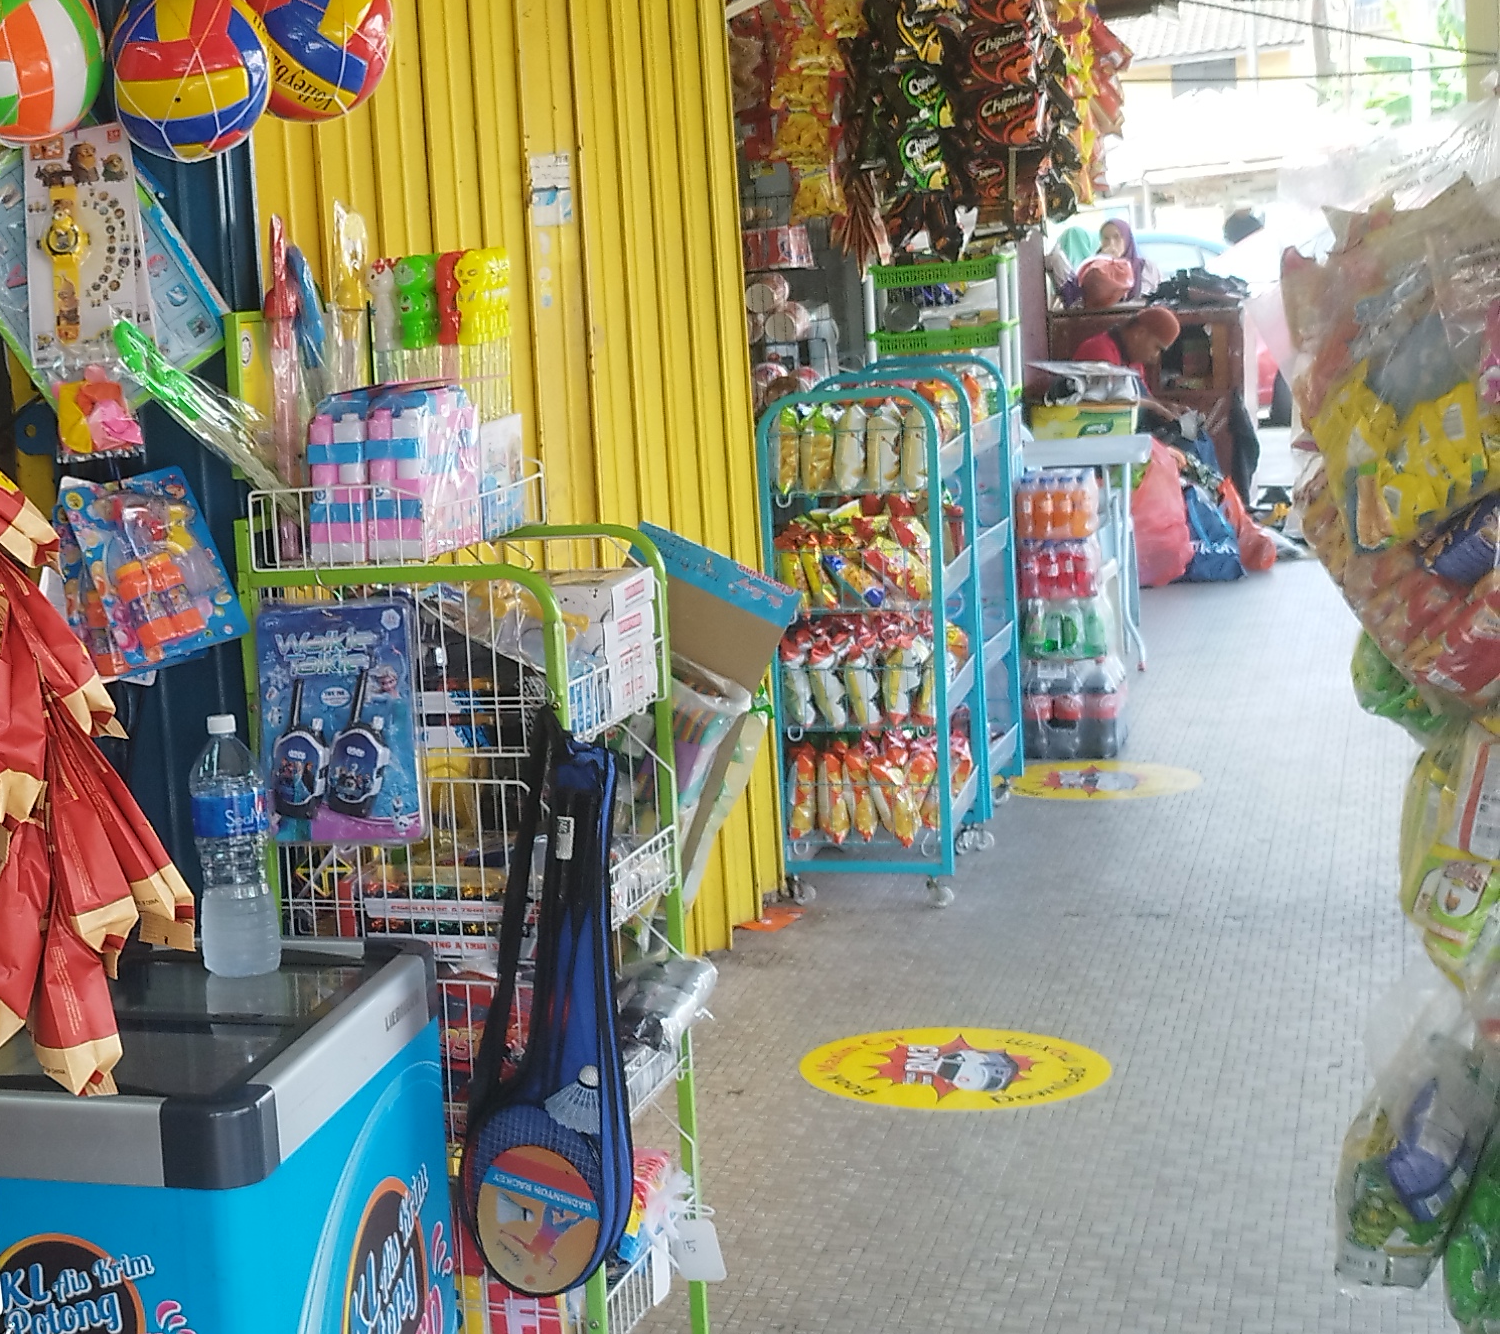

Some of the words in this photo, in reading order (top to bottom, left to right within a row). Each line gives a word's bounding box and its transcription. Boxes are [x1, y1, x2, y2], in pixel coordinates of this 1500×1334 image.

[981, 92, 1032, 117] Chipster
[2, 1263, 52, 1309] KL
[92, 1253, 156, 1288] Krim
